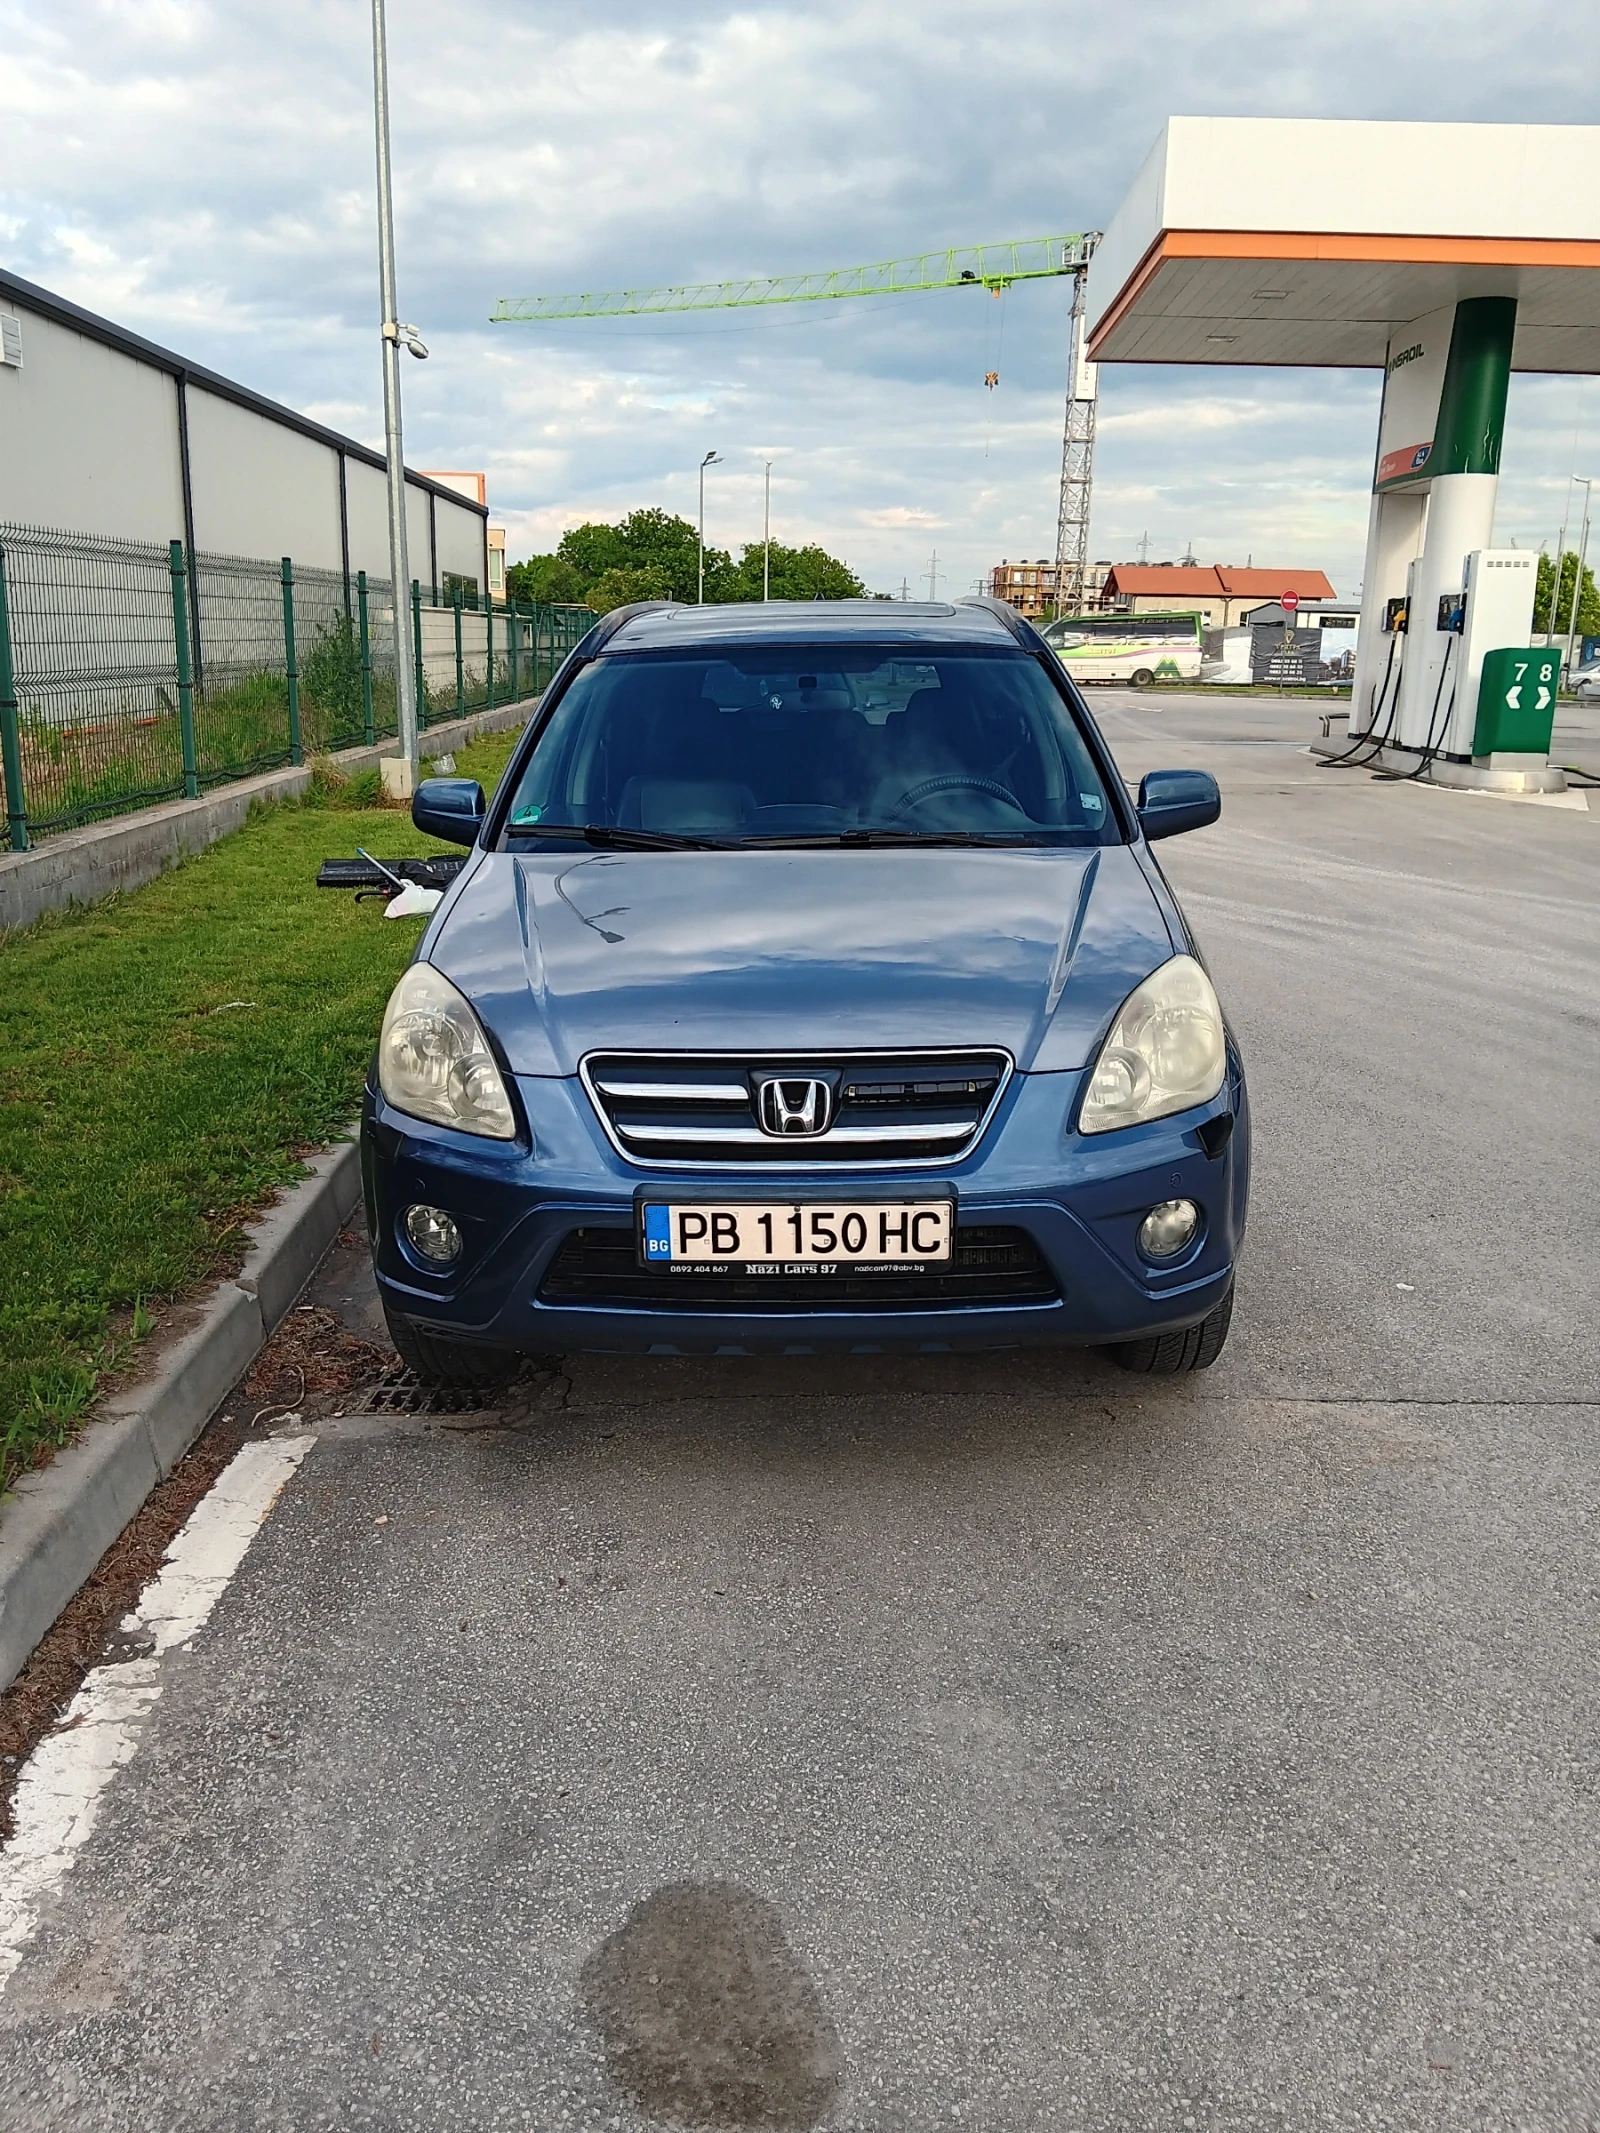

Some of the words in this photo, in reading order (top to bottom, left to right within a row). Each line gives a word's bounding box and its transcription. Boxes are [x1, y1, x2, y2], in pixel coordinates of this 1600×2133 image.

[1514, 663, 1529, 681] 7
[1539, 664, 1553, 682] 8
[678, 1212, 740, 1254] PB
[757, 1212, 867, 1254] 1150
[879, 1211, 942, 1253] HC
[649, 1240, 669, 1252] BG
[670, 1265, 692, 1273] 0892
[694, 1265, 710, 1273] 404
[712, 1265, 729, 1273] 867
[745, 1264, 780, 1274] Nazi
[784, 1263, 818, 1274] Cars
[820, 1264, 838, 1274] 97
